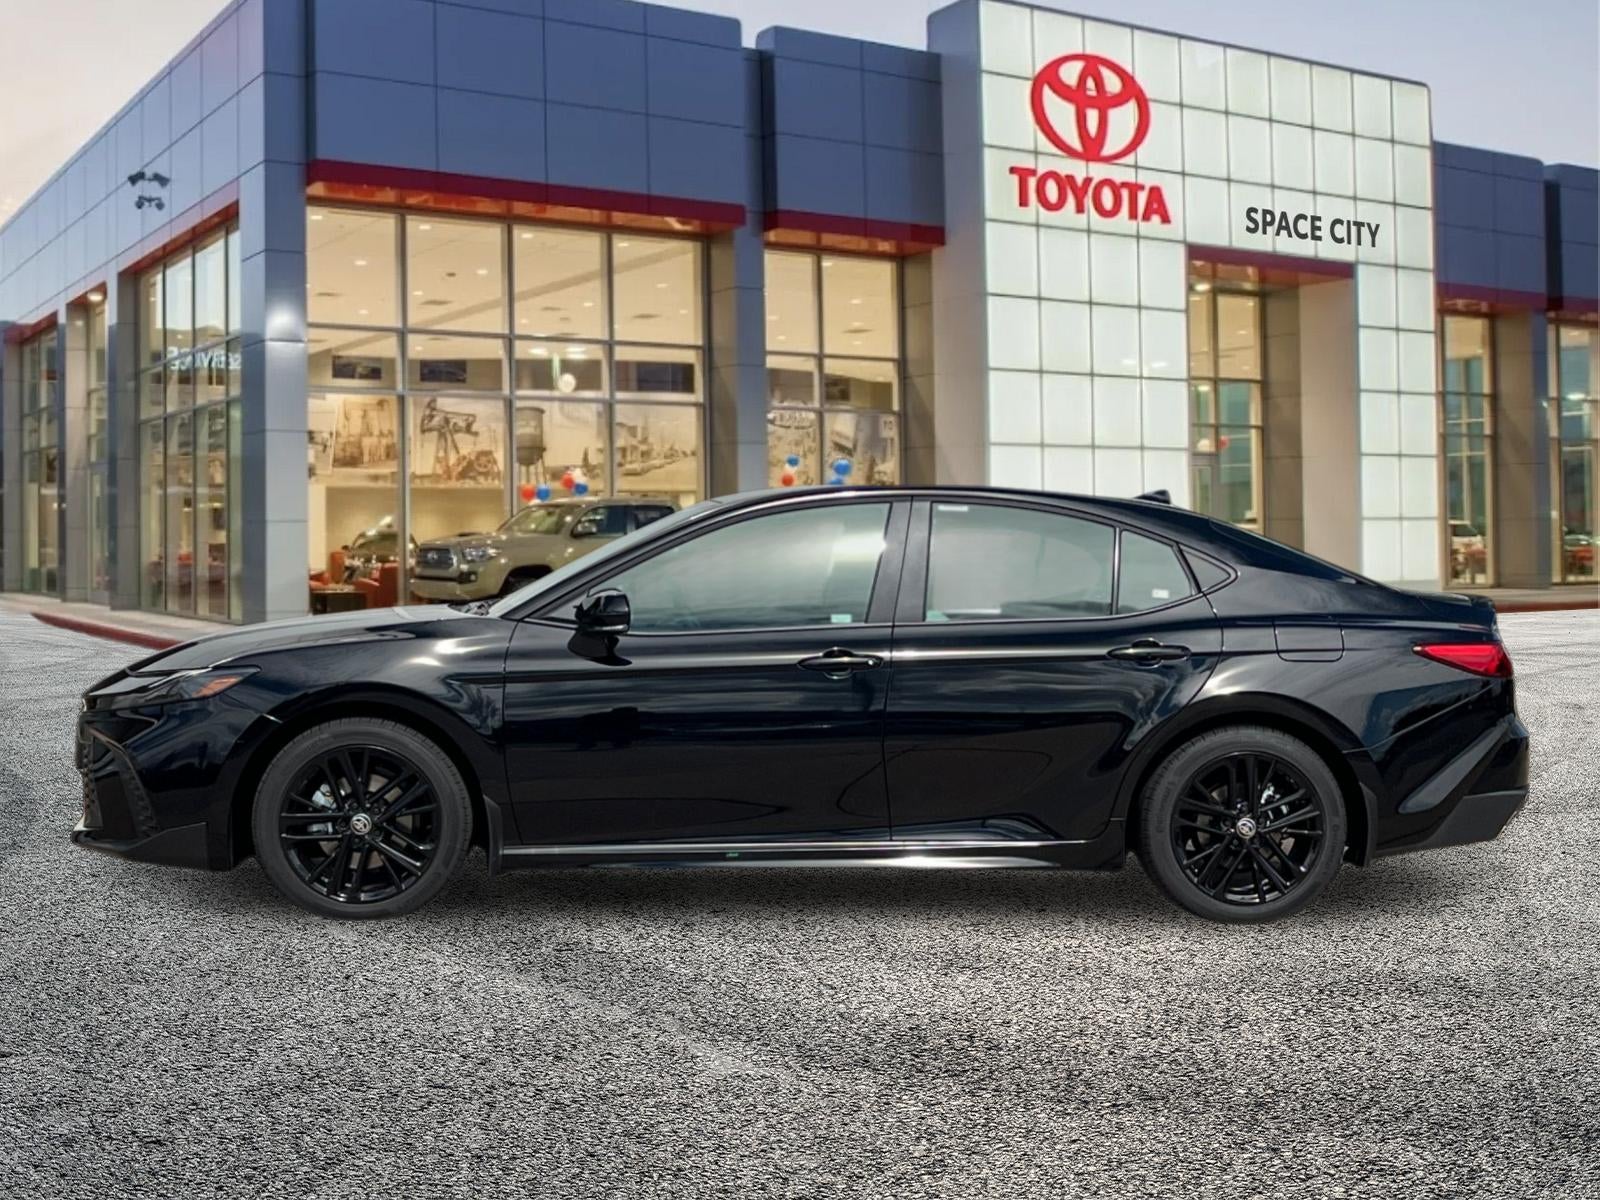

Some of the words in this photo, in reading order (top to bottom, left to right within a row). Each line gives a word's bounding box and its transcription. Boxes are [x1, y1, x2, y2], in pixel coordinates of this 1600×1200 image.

[1009, 166, 1171, 224] TOYOTA
[1245, 207, 1322, 241] SPACE
[1329, 218, 1380, 248] CITY
